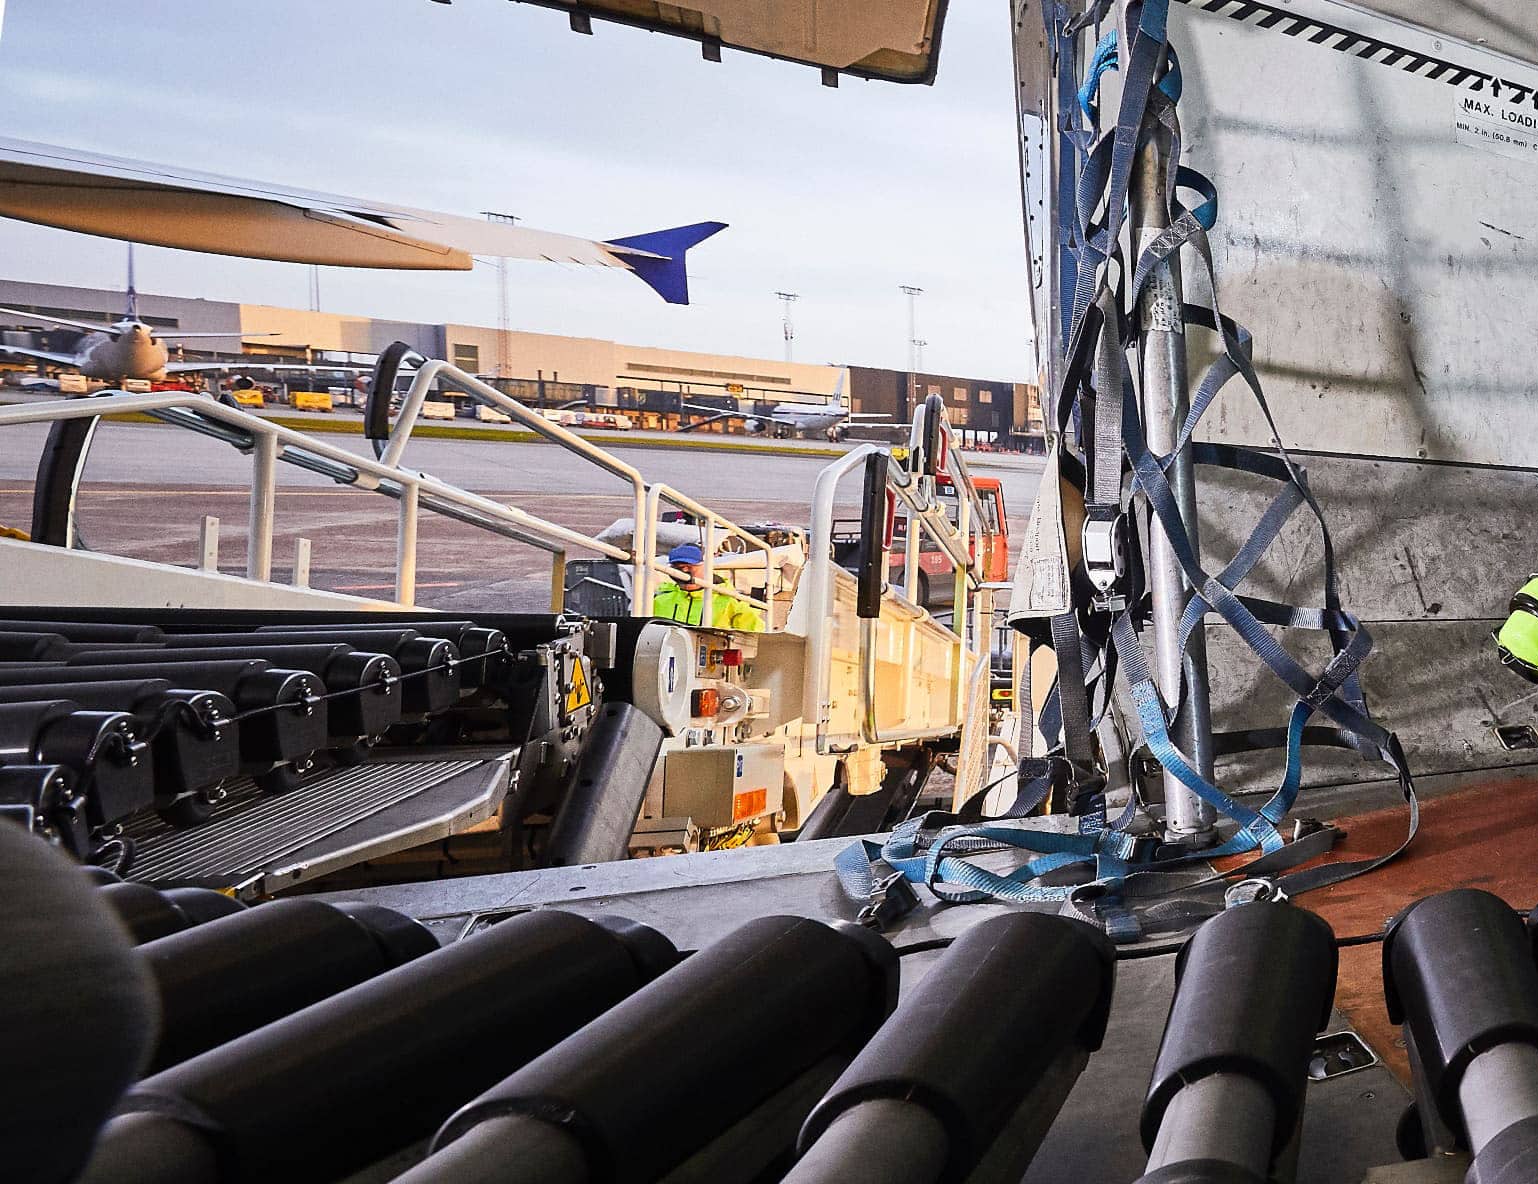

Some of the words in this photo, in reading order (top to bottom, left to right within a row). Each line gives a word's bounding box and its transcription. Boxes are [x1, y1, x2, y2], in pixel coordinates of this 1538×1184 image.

[1464, 98, 1494, 117] MAX.
[1456, 121, 1472, 132] MIN.
[1474, 127, 1480, 135] 2
[1492, 132, 1511, 143] (50.8
[1512, 139, 1528, 149] mm)
